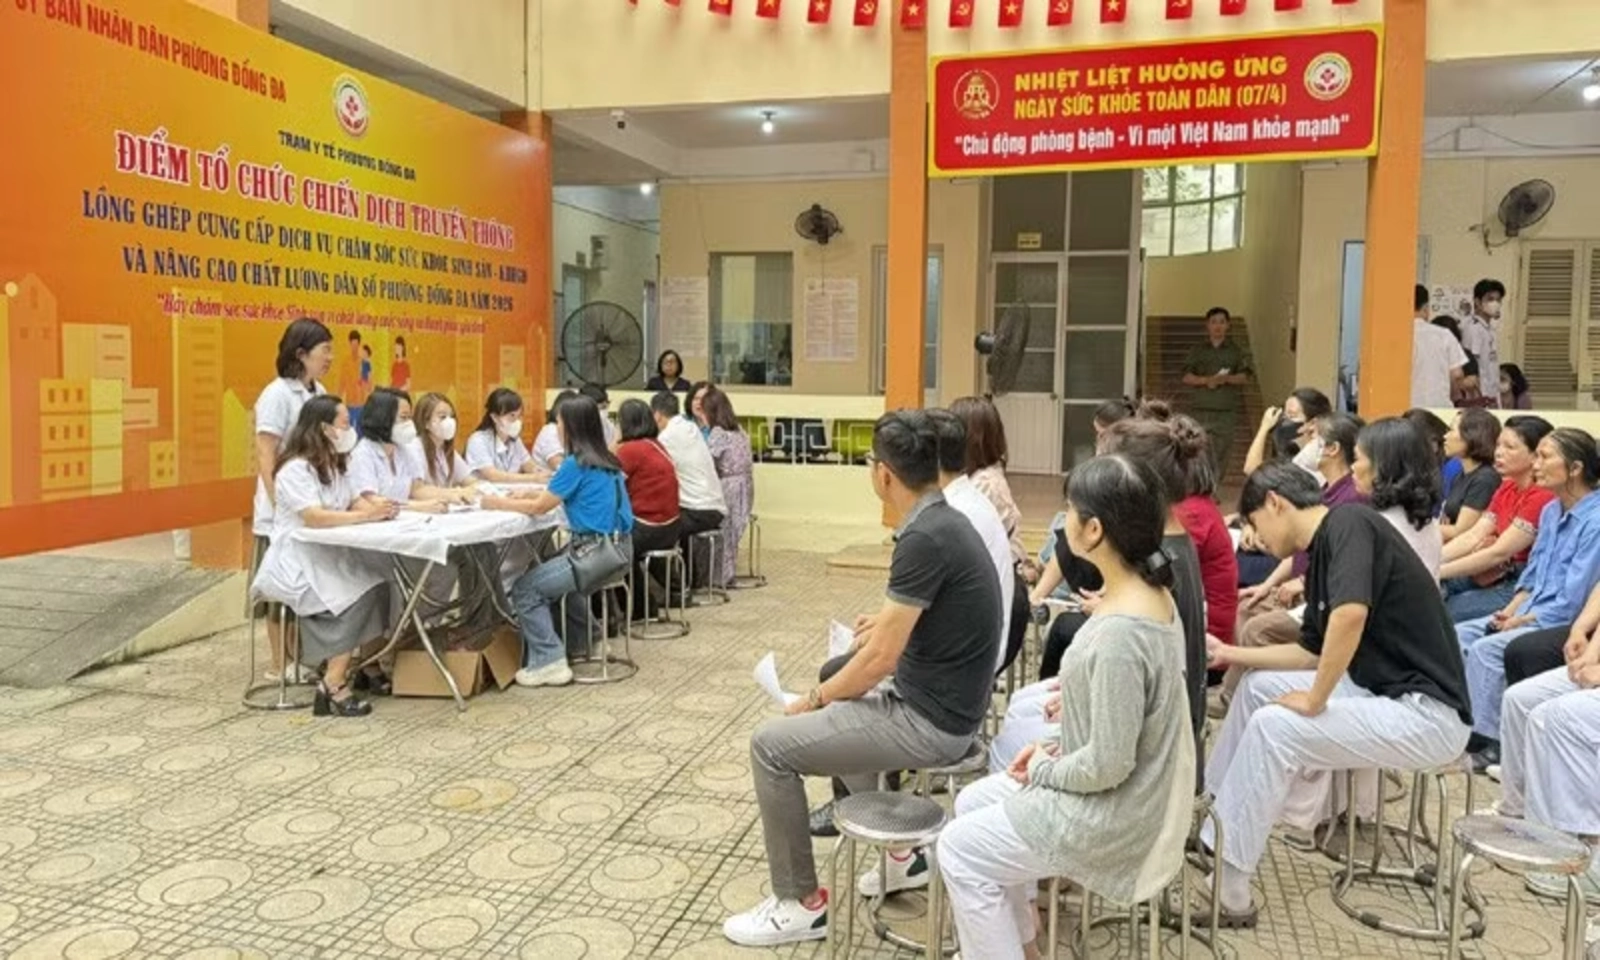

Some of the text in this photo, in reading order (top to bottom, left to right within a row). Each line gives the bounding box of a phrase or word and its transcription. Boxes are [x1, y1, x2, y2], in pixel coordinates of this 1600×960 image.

[45, 0, 82, 29] BAN
[138, 24, 169, 60] DÂN
[1014, 68, 1080, 94] NHIỆT
[1086, 63, 1132, 90] LIỆT
[1233, 54, 1288, 78] ỨNG
[1014, 83, 1288, 120] NGÀY SỨC KHỎE TOÀN DÂN (07/4)
[954, 131, 989, 156] "Chủ
[992, 132, 1027, 158] động
[1030, 129, 1075, 155] phòng
[1077, 126, 1115, 153] bệnh
[1147, 122, 1176, 149] một
[1180, 120, 1210, 148] Việt
[1213, 120, 1248, 142] Nam
[1252, 114, 1291, 140] khỏe
[1295, 114, 1350, 142] mạnh"
[116, 128, 191, 184] ĐIỂM
[197, 147, 230, 191] TỔ
[237, 163, 296, 205] CHỨC
[302, 178, 360, 220] CHIẾN
[366, 193, 406, 230] DỊCH
[82, 185, 136, 224] LỒNG
[142, 201, 191, 233] GHÉP
[197, 210, 240, 240] CUNG
[245, 215, 275, 245] CẤP
[279, 225, 312, 252] DỊCH
[316, 232, 333, 258] VỤ
[374, 240, 397, 265] SÓC
[123, 242, 148, 274] VÀ
[153, 247, 201, 279] NÂNG
[206, 257, 237, 283] CAO
[242, 258, 281, 288] CHẤT
[285, 267, 329, 294] LƯỢNG
[333, 271, 358, 296] DÂN
[361, 273, 377, 298] SỐ
